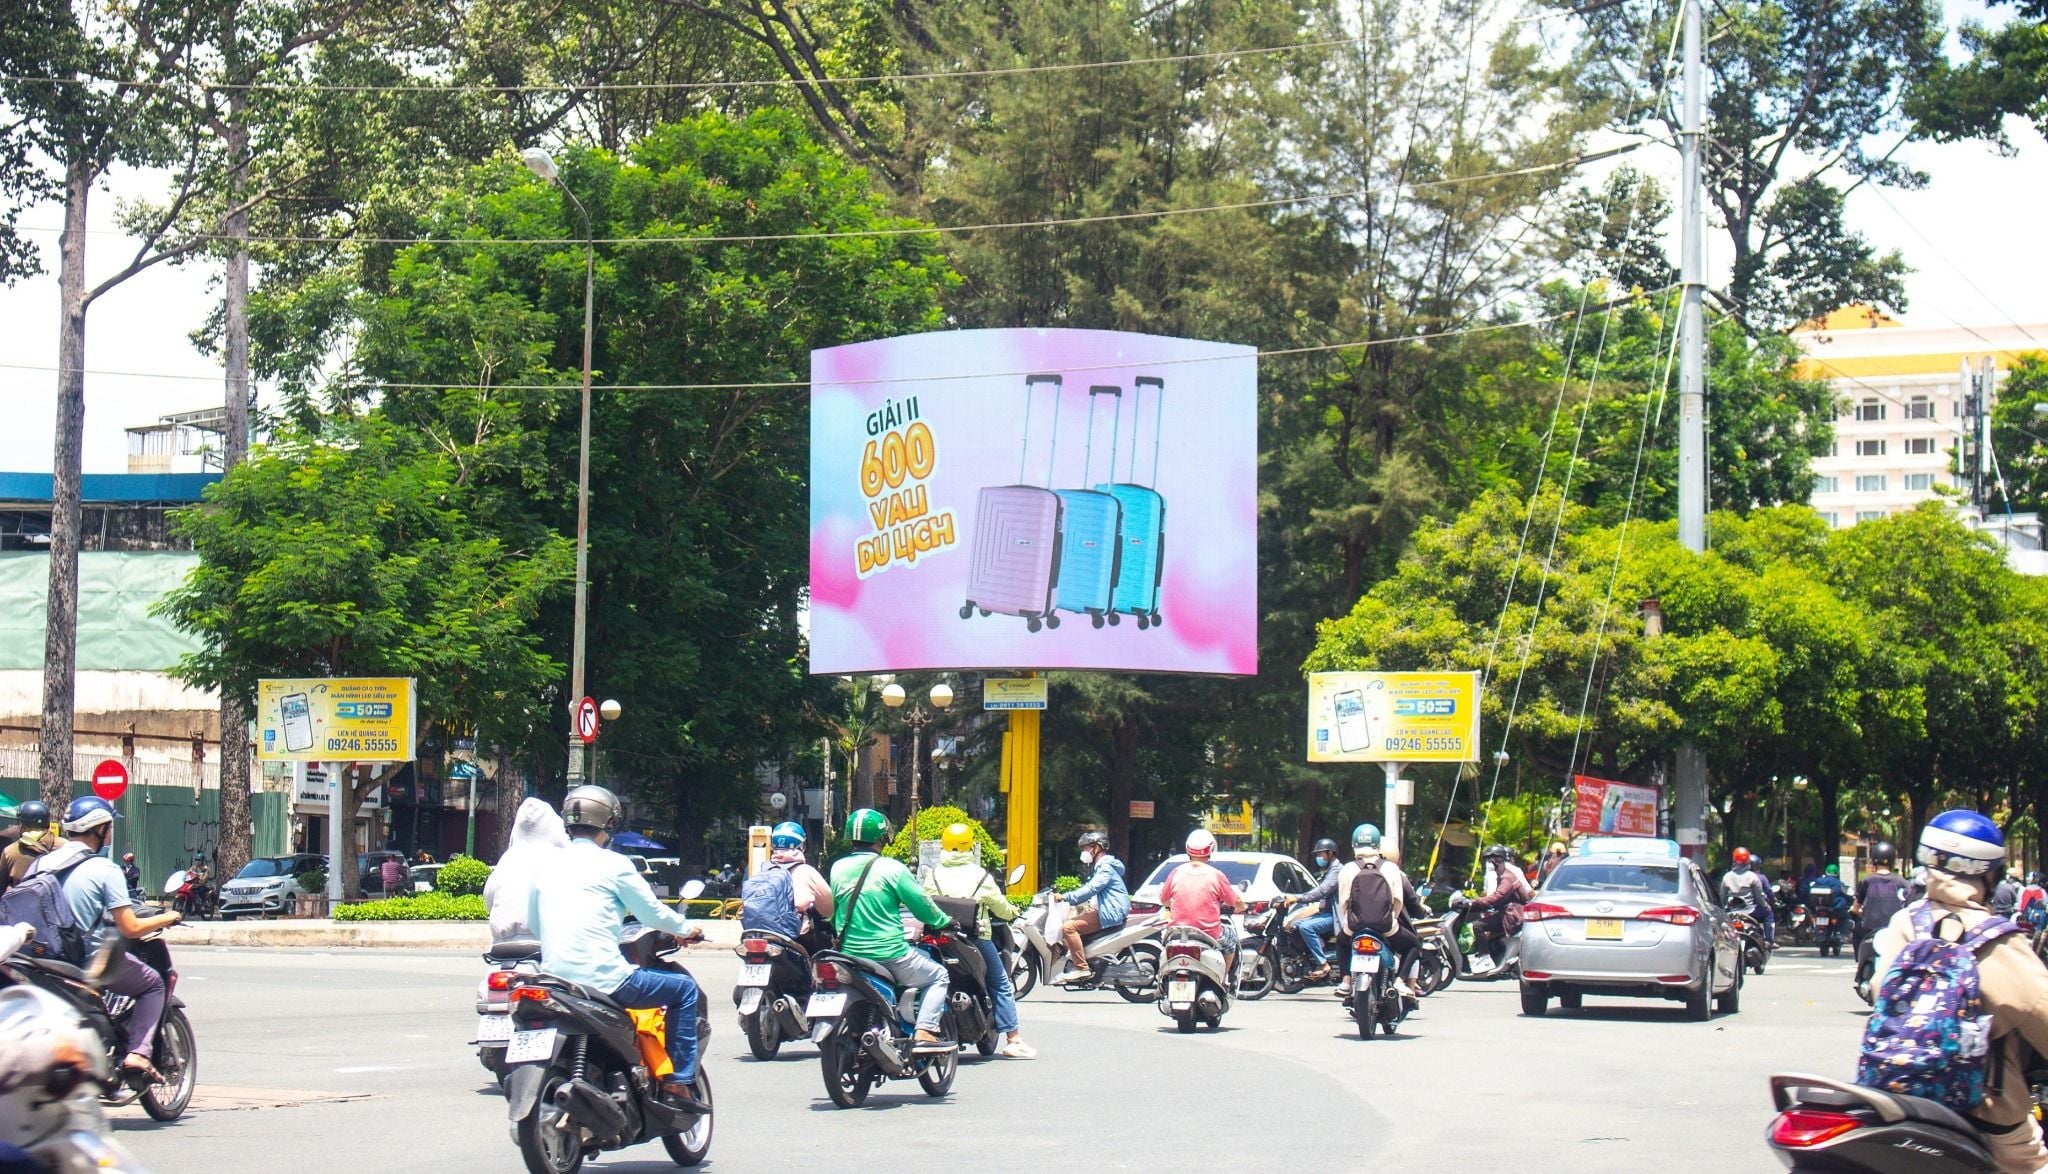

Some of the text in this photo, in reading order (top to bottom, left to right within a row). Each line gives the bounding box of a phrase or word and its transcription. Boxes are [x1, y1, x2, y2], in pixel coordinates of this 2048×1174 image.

[866, 399, 902, 436] GIẢI
[861, 422, 935, 498] 600
[870, 484, 928, 531] VALI
[857, 512, 955, 573] DU LỊCH
[357, 704, 373, 716] 50
[1417, 701, 1435, 713] 50
[327, 738, 398, 751] 09246.55555
[1386, 738, 1462, 751] 09246.55555
